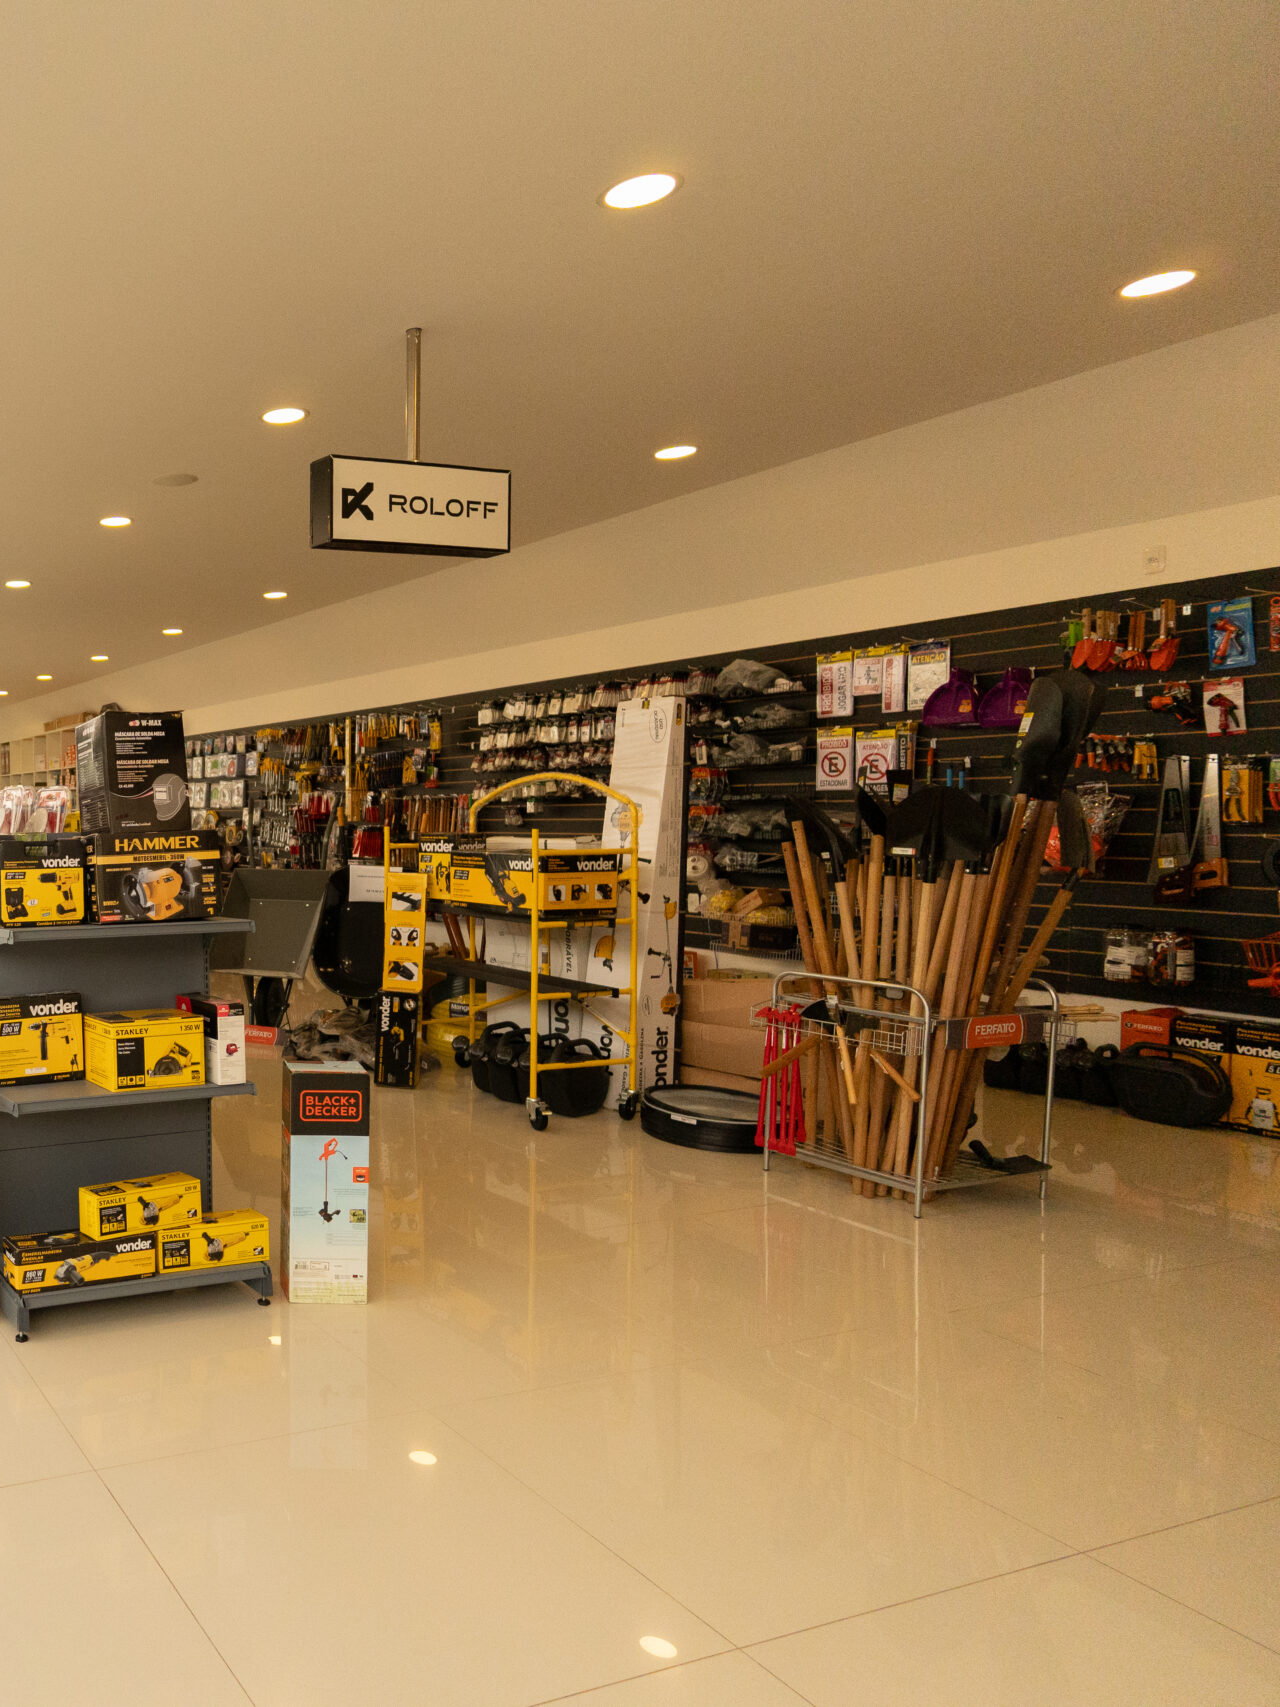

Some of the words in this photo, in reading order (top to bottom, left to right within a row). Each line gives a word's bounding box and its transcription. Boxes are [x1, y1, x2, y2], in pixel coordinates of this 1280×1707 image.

[388, 494, 499, 519] ROLOFF
[912, 652, 945, 665] ATENÇÃO
[822, 670, 832, 711] PROIBIDO
[837, 686, 846, 711] JOGAR
[820, 779, 848, 787] ESTACIONAR
[114, 835, 200, 852] HAMMER
[420, 840, 454, 853] vonder
[41, 855, 80, 868] vonder
[576, 857, 614, 871] vonder
[29, 998, 78, 1016] vonder
[379, 996, 391, 1032] vonder
[116, 1028, 149, 1036] STANLEY
[1175, 1036, 1224, 1051] vonder
[651, 1026, 669, 1087] onder
[1235, 1044, 1280, 1060] vonde
[305, 1095, 356, 1106] BLACK+
[305, 1106, 357, 1116] DECKER
[98, 1196, 127, 1207] STANLEY
[161, 1232, 190, 1240] STANLEY
[116, 1238, 152, 1253] vonder
